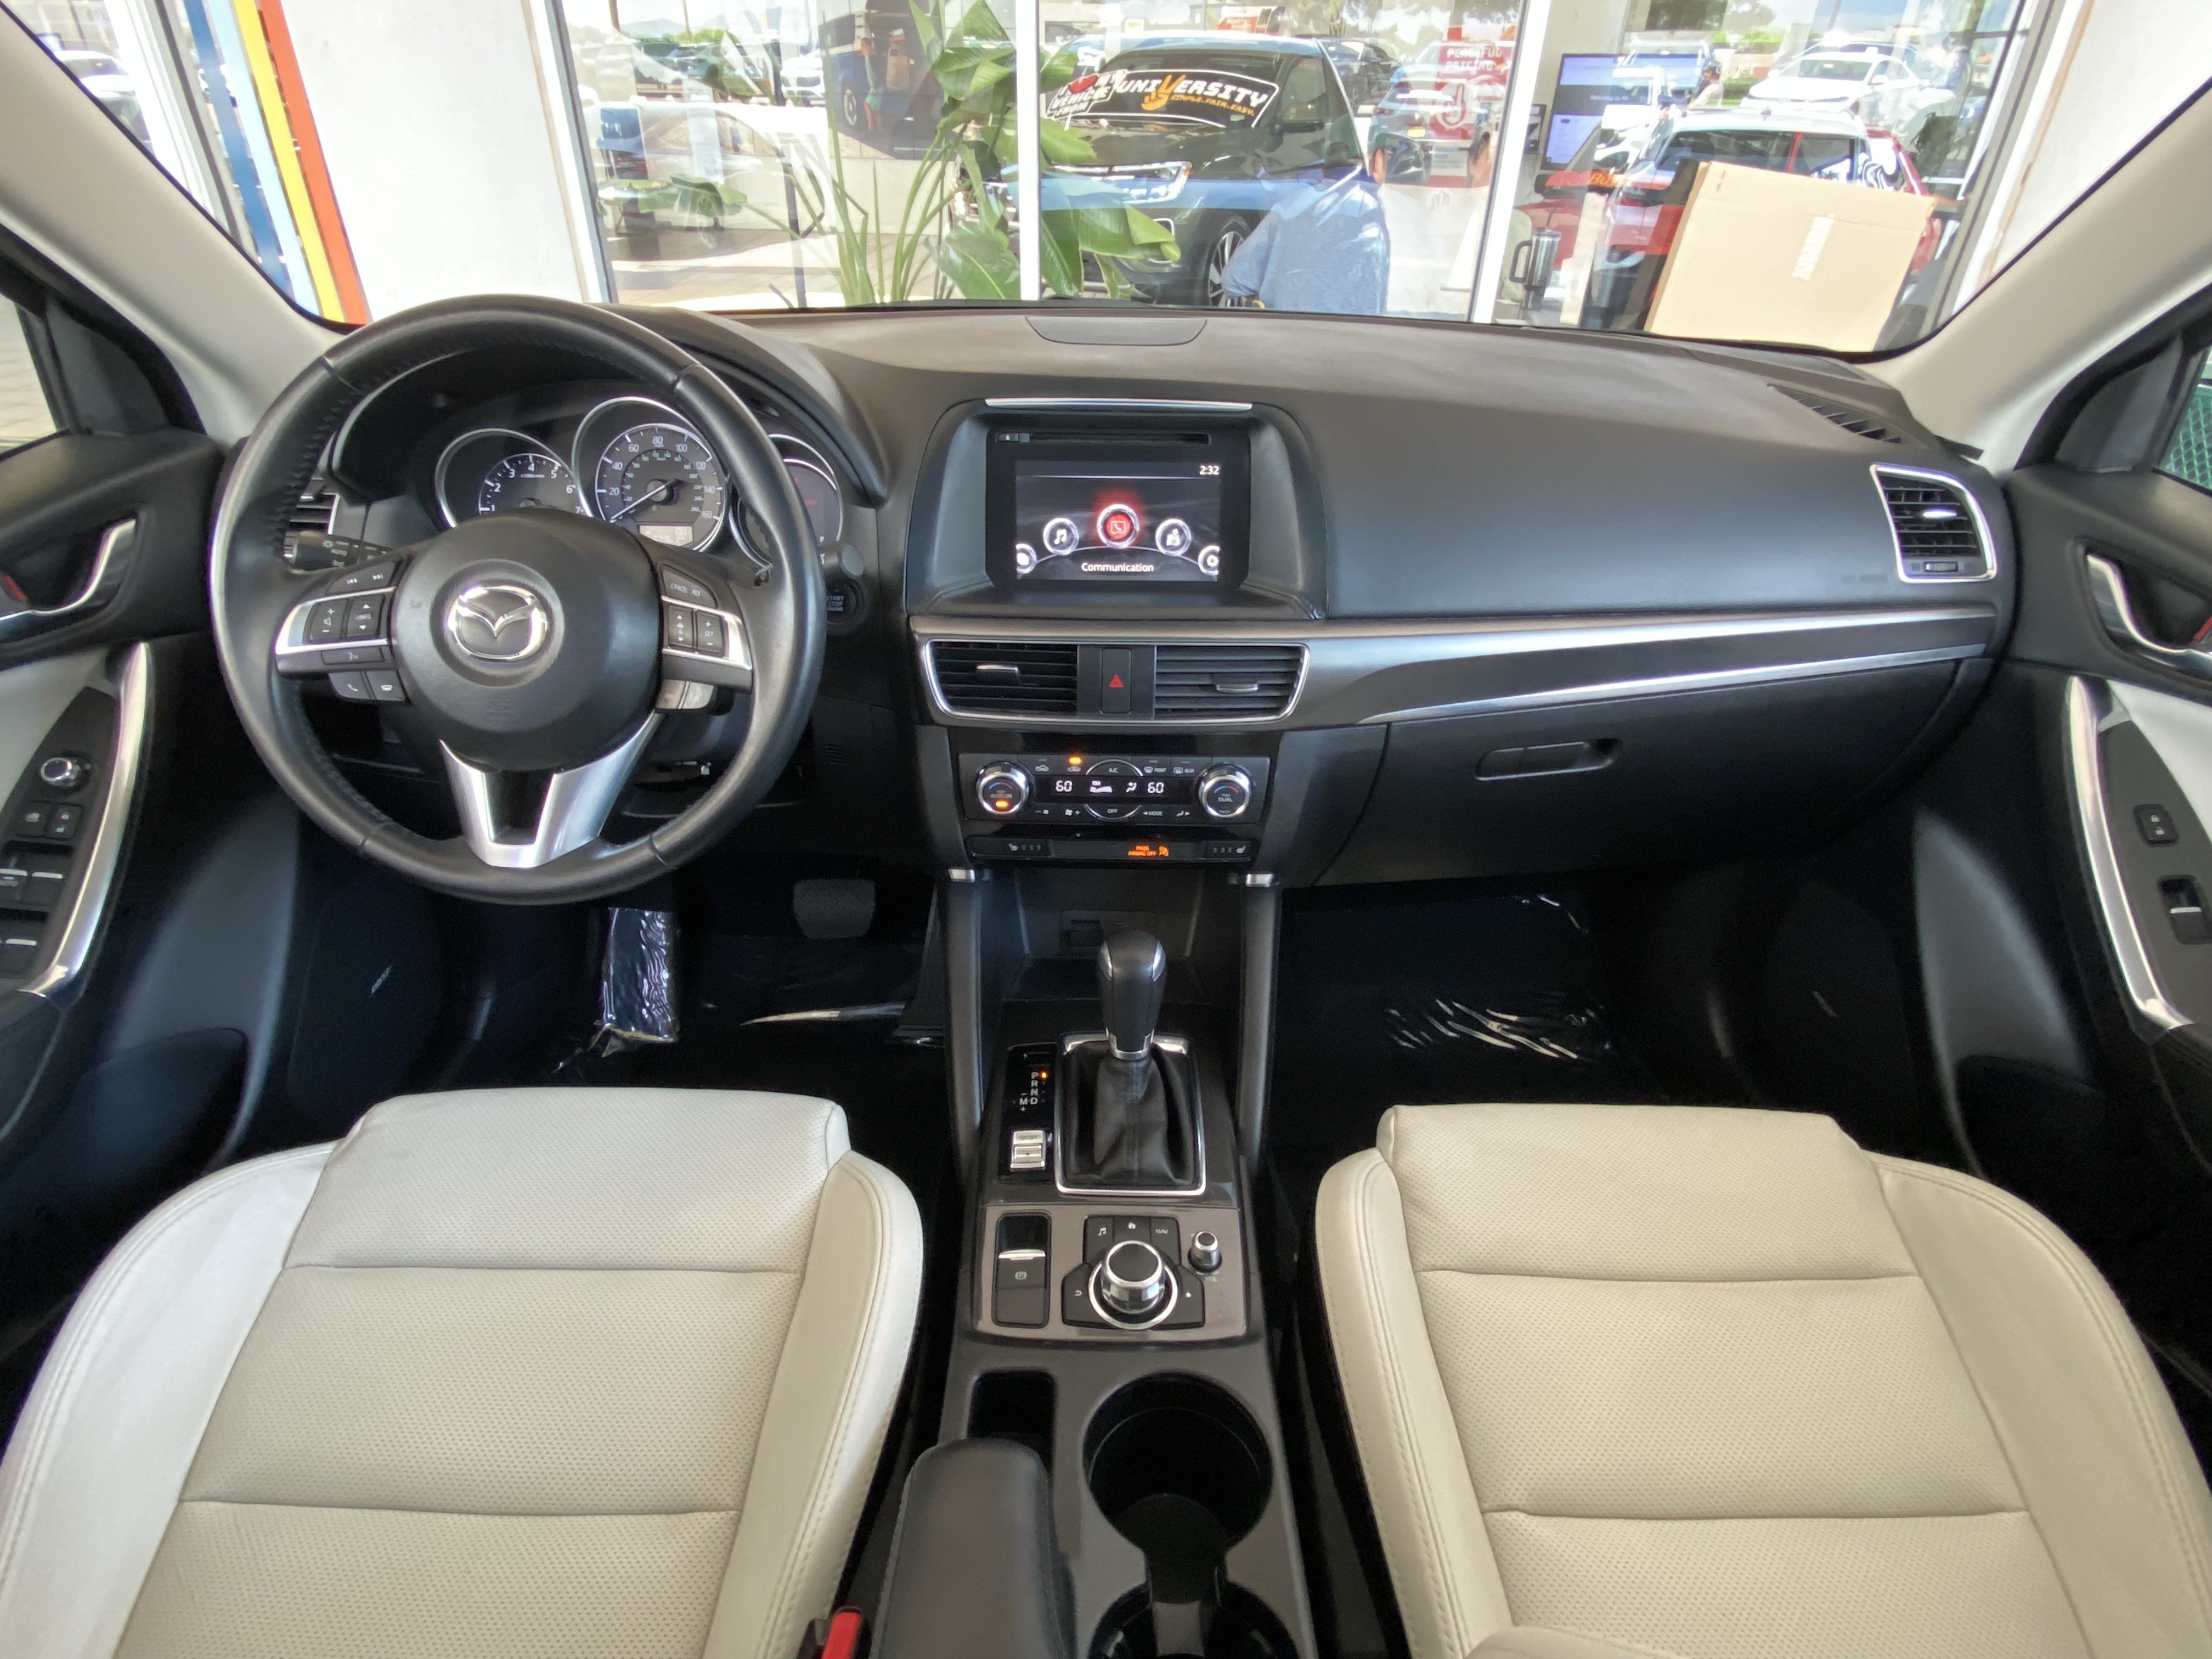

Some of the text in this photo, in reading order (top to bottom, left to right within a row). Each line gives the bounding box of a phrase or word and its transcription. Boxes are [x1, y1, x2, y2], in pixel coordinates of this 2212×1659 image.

[1115, 74, 1268, 109] UNIVERSITY
[652, 436, 663, 444] 80
[628, 444, 639, 452] 60
[676, 444, 688, 452] 100
[528, 463, 534, 471] 4
[612, 461, 623, 470] 40
[696, 461, 707, 470] 120
[1199, 465, 1220, 475] 2:32
[509, 469, 516, 478] 3
[550, 470, 557, 478] 5
[494, 483, 501, 492] 2
[566, 484, 573, 494] 6
[609, 488, 619, 496] 20
[1081, 562, 1154, 572] Communication
[1056, 780, 1073, 792] 60
[1147, 782, 1165, 793] 60
[1030, 1088, 1039, 1096] N
